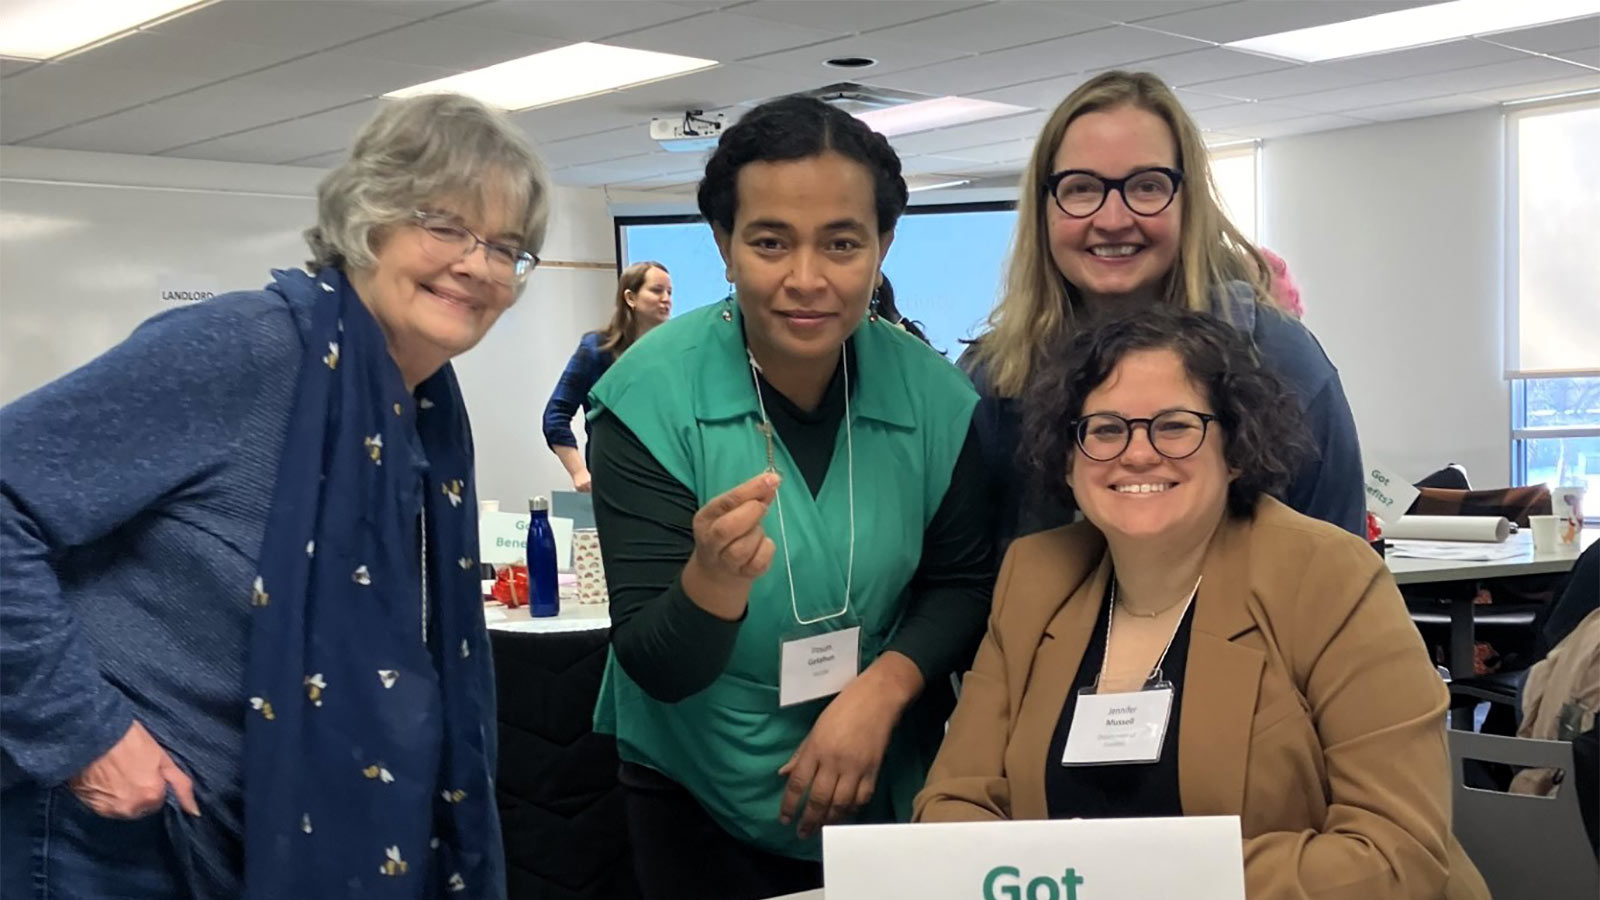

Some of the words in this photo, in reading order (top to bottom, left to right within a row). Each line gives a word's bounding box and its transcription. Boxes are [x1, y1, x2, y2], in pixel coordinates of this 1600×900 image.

[162, 291, 215, 301] LANDLORD
[1371, 469, 1391, 486] Got
[1366, 485, 1394, 507] efits?
[515, 520, 531, 531] Go
[1108, 706, 1137, 716] Jennifer
[1105, 717, 1135, 726] Mussell
[983, 865, 1084, 900] Got
